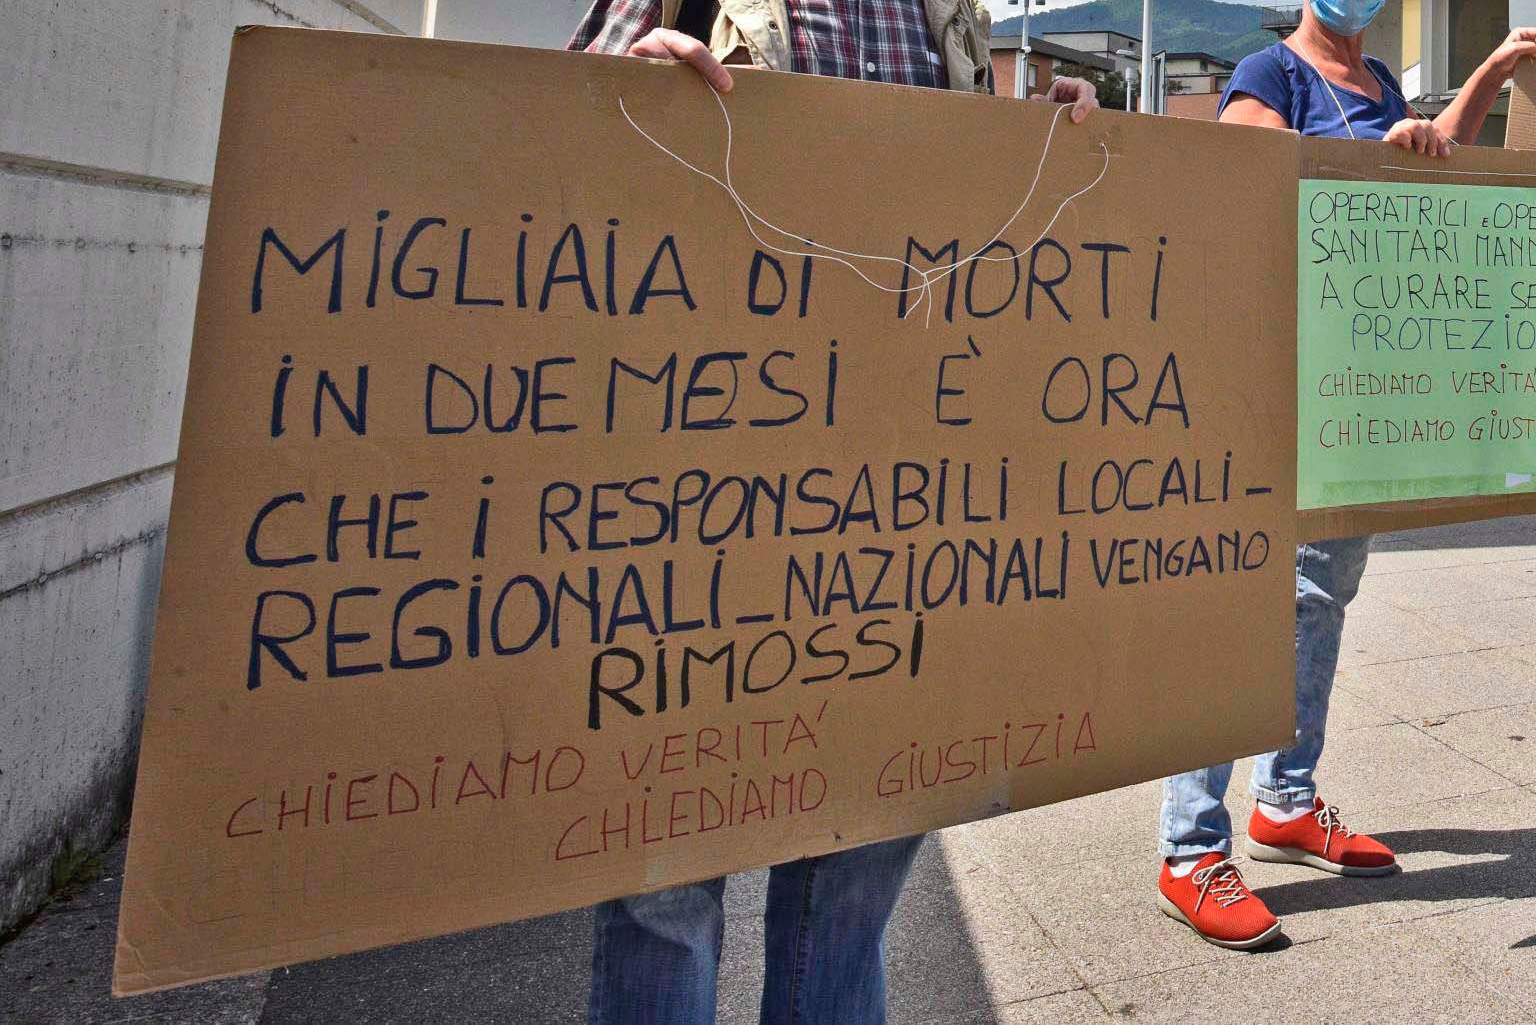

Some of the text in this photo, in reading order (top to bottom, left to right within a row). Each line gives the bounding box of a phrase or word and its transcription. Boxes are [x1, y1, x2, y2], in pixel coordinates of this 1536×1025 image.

[1310, 191, 1468, 228] OPERATRICI
[1311, 227, 1461, 265] SANITARI
[251, 210, 1169, 324] MIGLIAIA DI MORTI
[1320, 272, 1344, 310] A
[1353, 274, 1493, 310] CURARE
[270, 354, 369, 438] IN
[426, 356, 579, 437] DUE
[606, 339, 838, 433] MESI
[1042, 352, 1191, 429] ORA
[1318, 365, 1432, 397] CHIEDIAMO
[1319, 413, 1455, 448] CHIEDIAMO
[245, 490, 430, 568] CHE
[540, 456, 1010, 555] RESPONSABILI
[1090, 529, 1271, 590] VENGANO
[587, 612, 925, 731] RIMOSSI
[226, 746, 585, 839] CHIEDIAMO
[876, 711, 1099, 800] GIUSTIZIA
